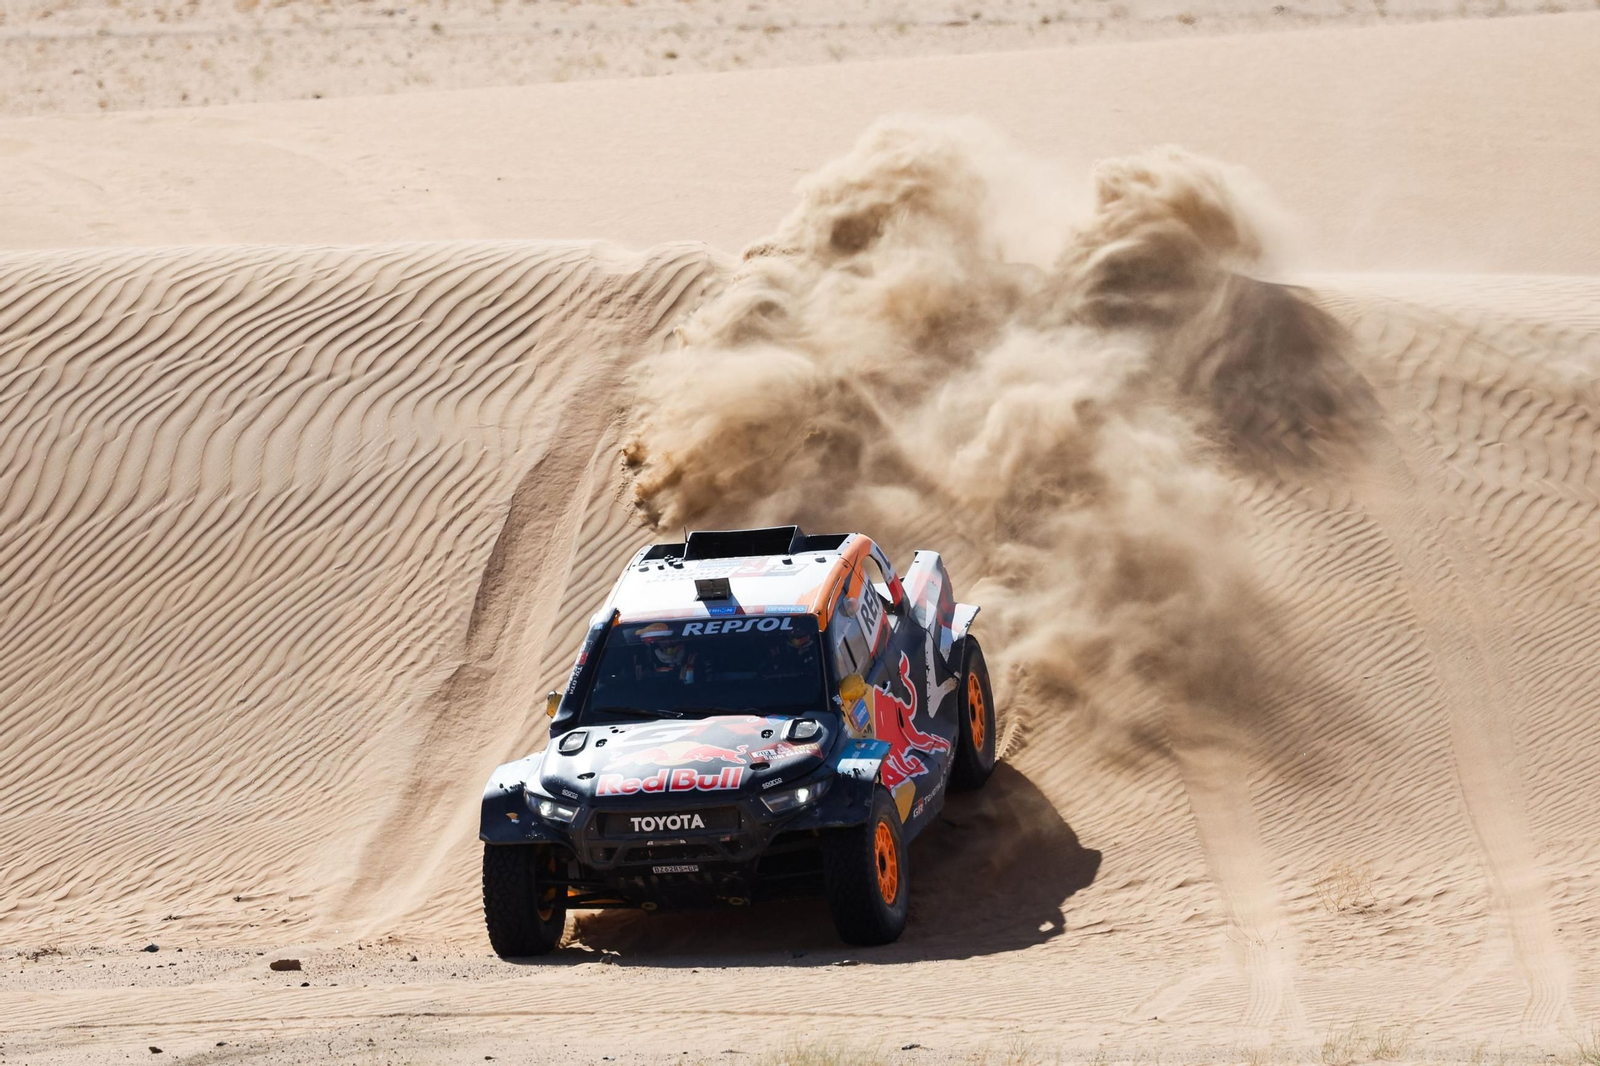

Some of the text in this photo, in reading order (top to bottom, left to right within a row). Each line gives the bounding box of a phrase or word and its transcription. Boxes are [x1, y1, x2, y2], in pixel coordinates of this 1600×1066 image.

[682, 618, 793, 636] REPSOL
[596, 767, 745, 796] Red Bull
[630, 814, 705, 832] TOYOTA
